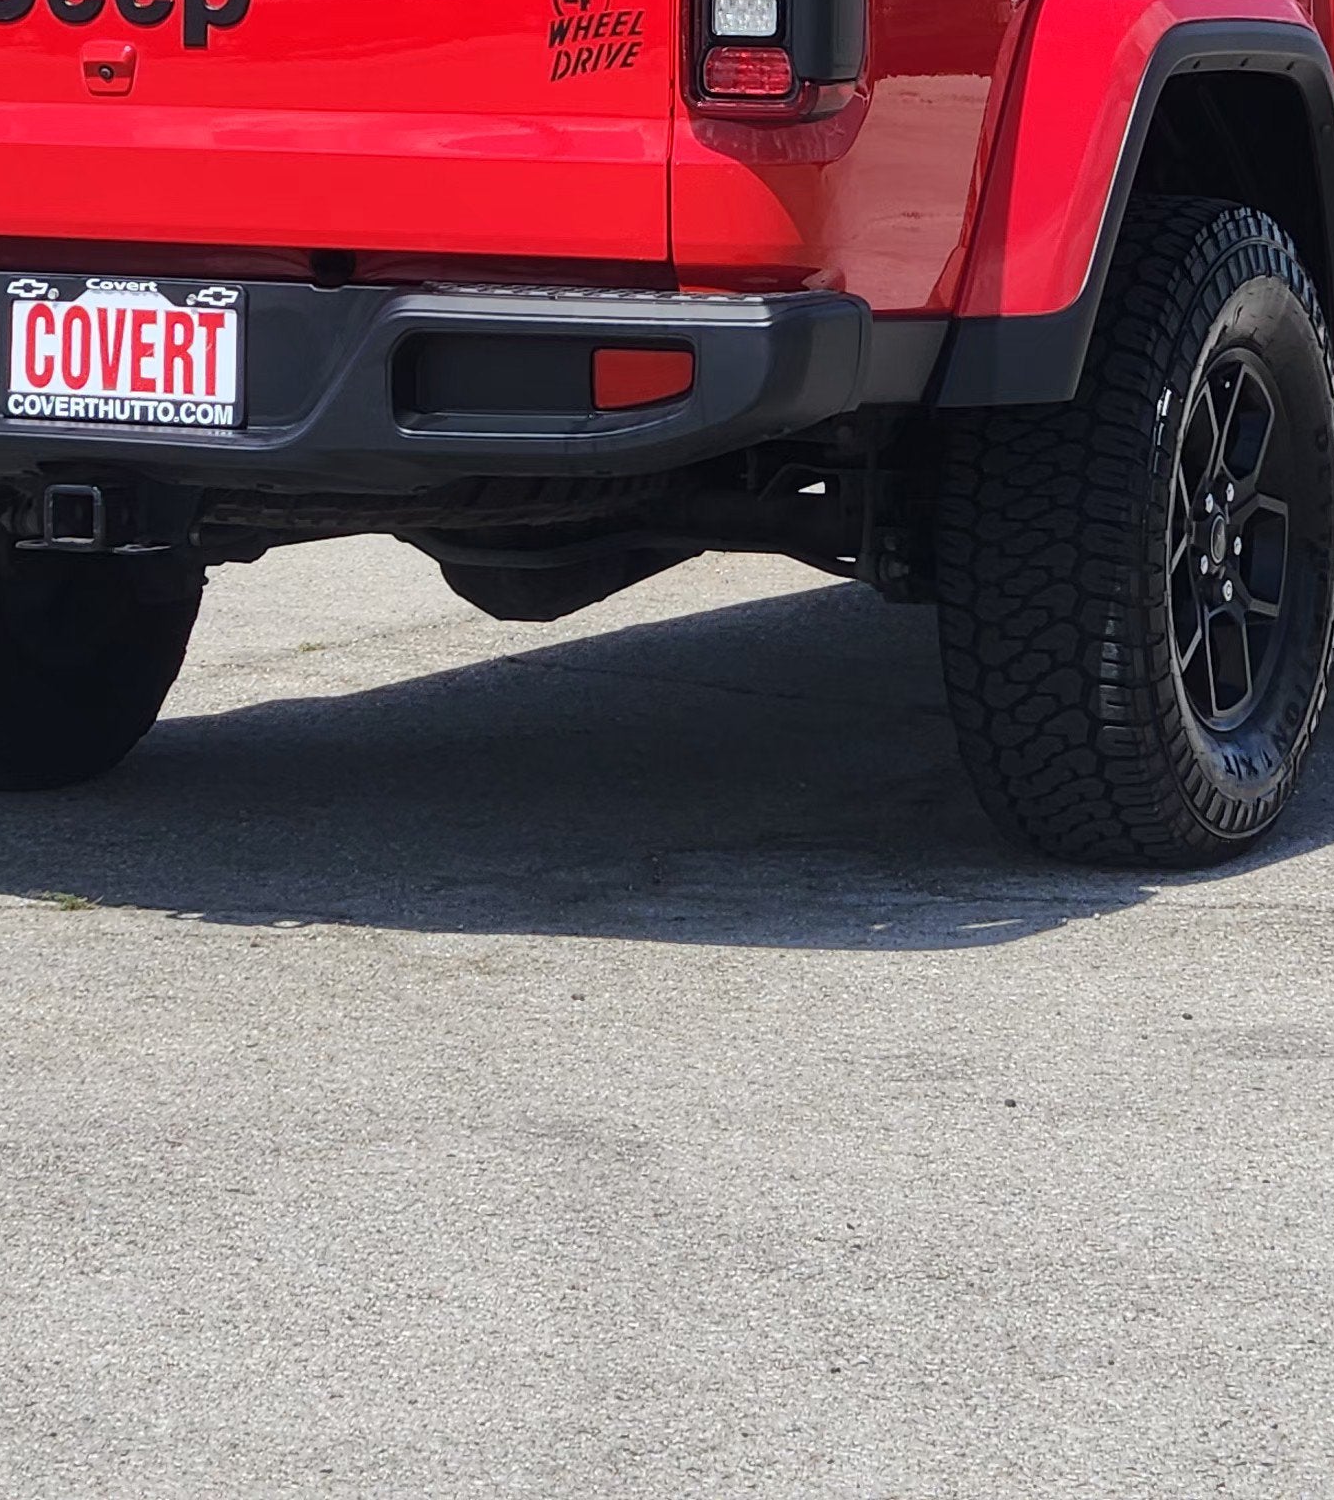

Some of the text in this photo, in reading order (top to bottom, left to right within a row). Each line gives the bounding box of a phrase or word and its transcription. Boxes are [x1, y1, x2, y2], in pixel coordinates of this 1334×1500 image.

[548, 11, 645, 48] WHEEL
[551, 41, 643, 81] DRIVE
[85, 278, 158, 292] Covert
[25, 303, 225, 396] COVERT
[7, 394, 233, 425] COVERTHUTTO.COM
